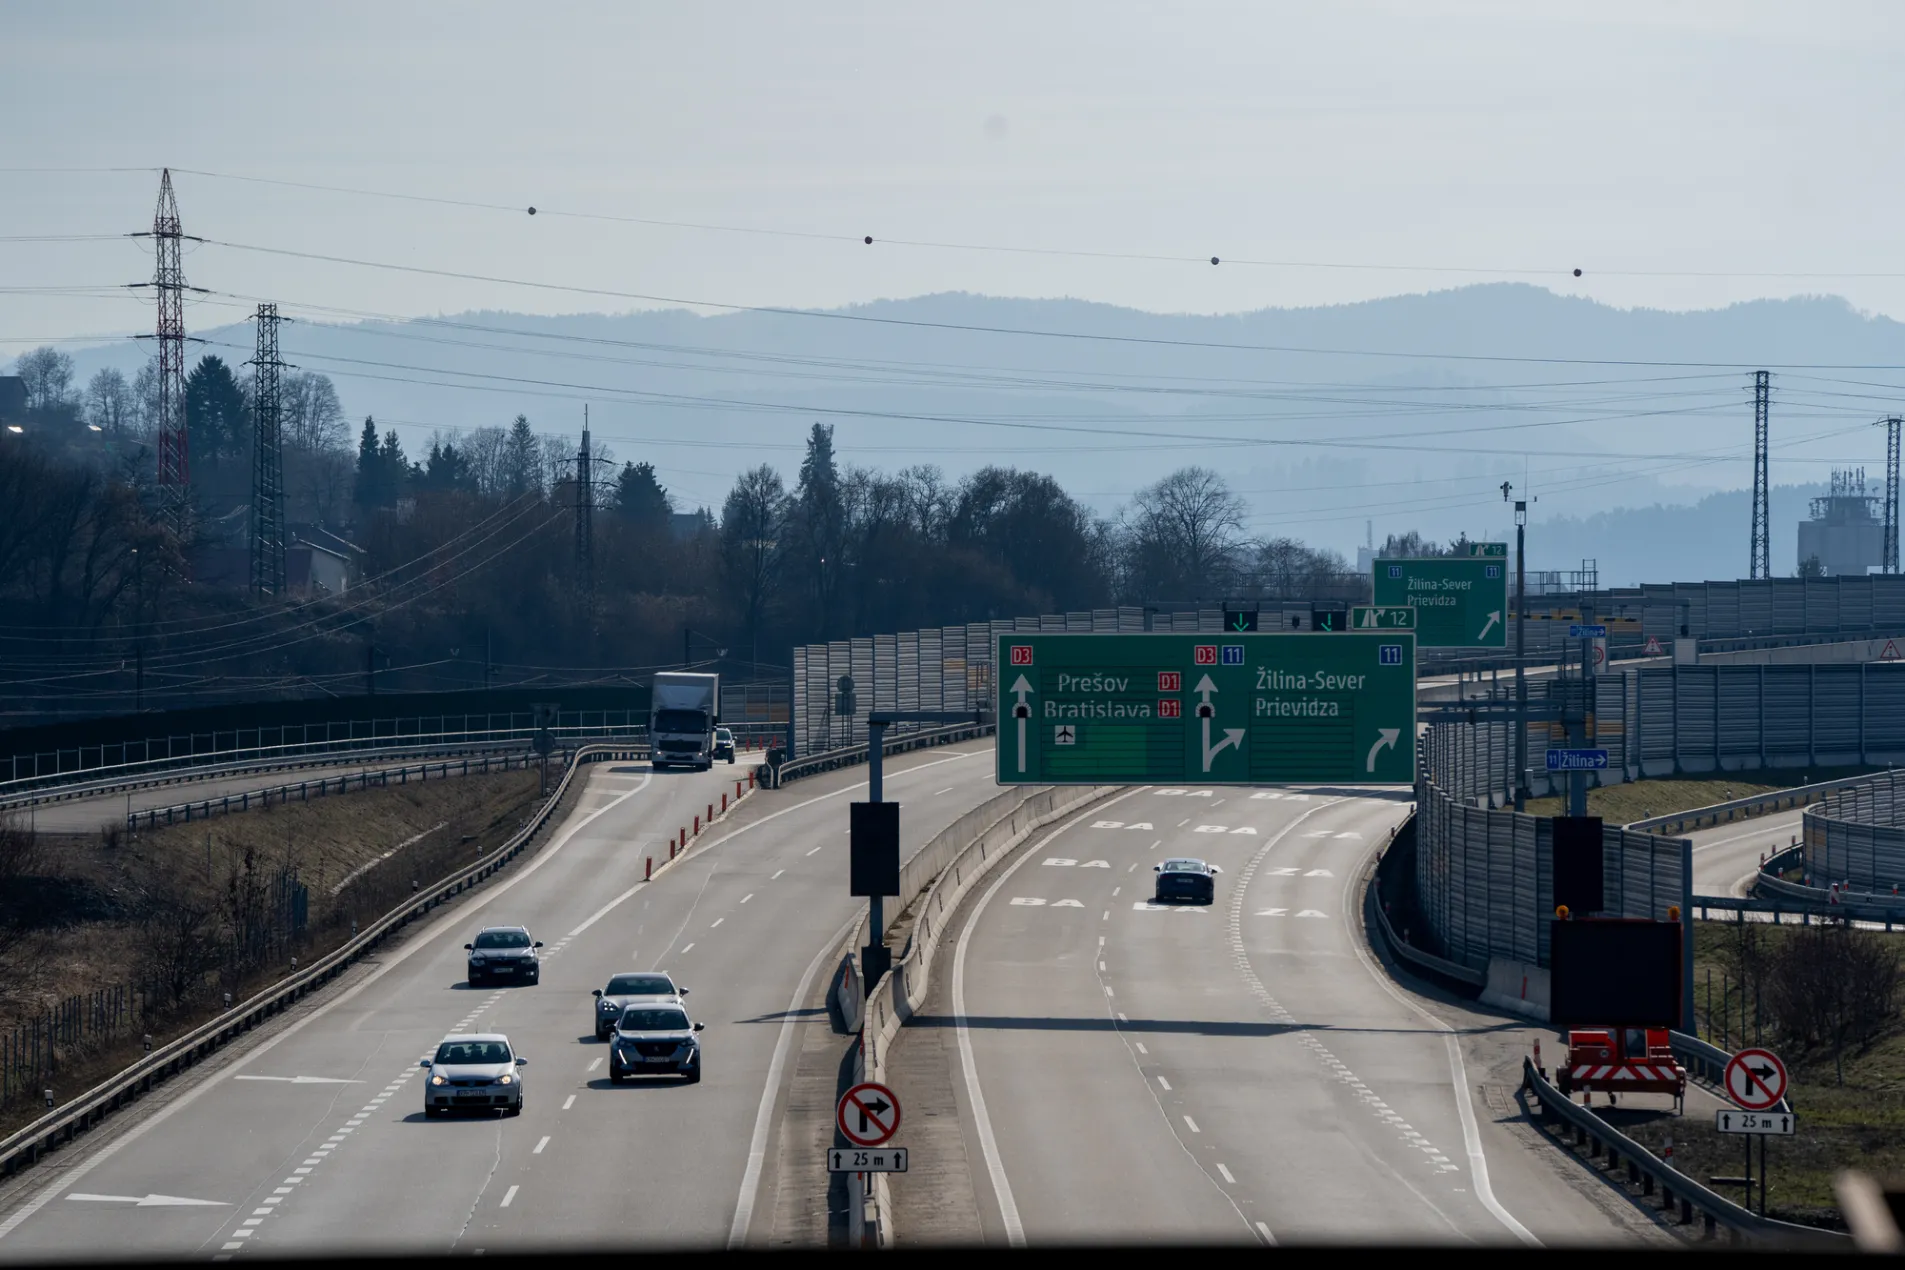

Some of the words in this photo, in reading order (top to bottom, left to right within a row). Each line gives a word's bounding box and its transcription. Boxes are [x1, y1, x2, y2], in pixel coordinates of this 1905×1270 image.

[1492, 546, 1502, 555] 12
[1391, 567, 1400, 577] 11
[1488, 567, 1497, 577] 11
[1407, 576, 1473, 590] Žilina-Sever
[1407, 594, 1457, 606] Prievidza
[1390, 611, 1407, 626] 12
[1013, 648, 1030, 664] D3
[1197, 647, 1215, 663] D3
[1227, 647, 1241, 663] 11
[1384, 647, 1398, 663] 11
[1058, 672, 1129, 692] Prešov
[1161, 674, 1179, 690] D1
[1256, 666, 1366, 690] Žilina-Sever
[1044, 700, 1151, 718] Bratislava
[1161, 701, 1179, 717] D1
[1256, 697, 1339, 717] Prievidza
[1548, 753, 1557, 765] 11
[1561, 751, 1594, 768] Žilina
[1090, 820, 1154, 830] BA
[1193, 824, 1258, 835] BA
[1301, 830, 1363, 840] ZA
[1041, 857, 1111, 869] BA
[1265, 867, 1335, 878] ZA
[1009, 896, 1085, 908] BA
[1254, 907, 1329, 919] ZA
[1742, 1115, 1757, 1128] 25
[1762, 1119, 1772, 1128] m
[853, 1152, 868, 1166] 25
[874, 1156, 884, 1166] m
